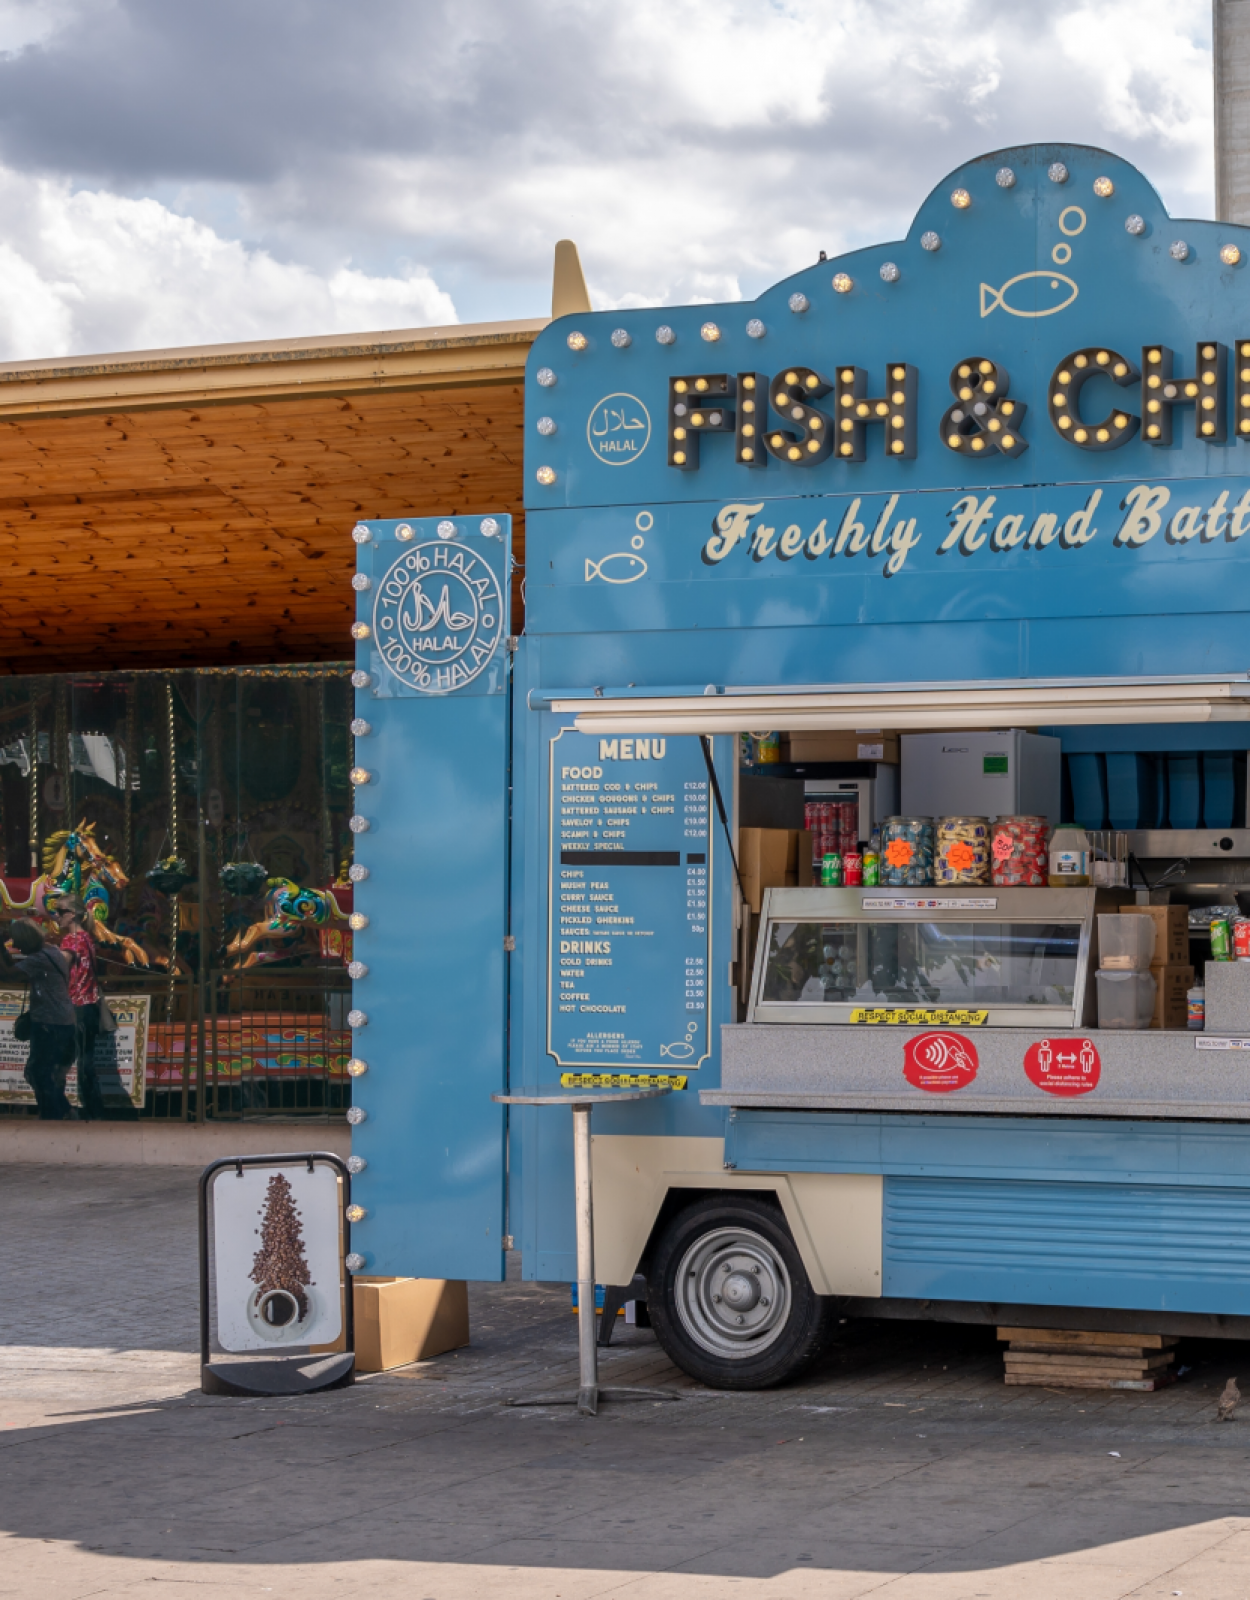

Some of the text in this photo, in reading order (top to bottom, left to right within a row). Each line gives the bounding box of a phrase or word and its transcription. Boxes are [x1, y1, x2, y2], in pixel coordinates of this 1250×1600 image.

[668, 362, 919, 472] FISH
[939, 356, 1030, 460] &
[600, 439, 639, 453] HALAL
[701, 494, 922, 578] Freshly
[935, 488, 1103, 557] Hand
[382, 547, 497, 611] 100% HALAL
[413, 636, 462, 651] HALAL
[382, 636, 496, 688] 100% HALAL
[600, 739, 665, 759] MENU
[562, 766, 602, 778] FOOD
[561, 941, 610, 953] DRINKS
[859, 1012, 980, 1022] RESPECT SOCIAL DISTANCING
